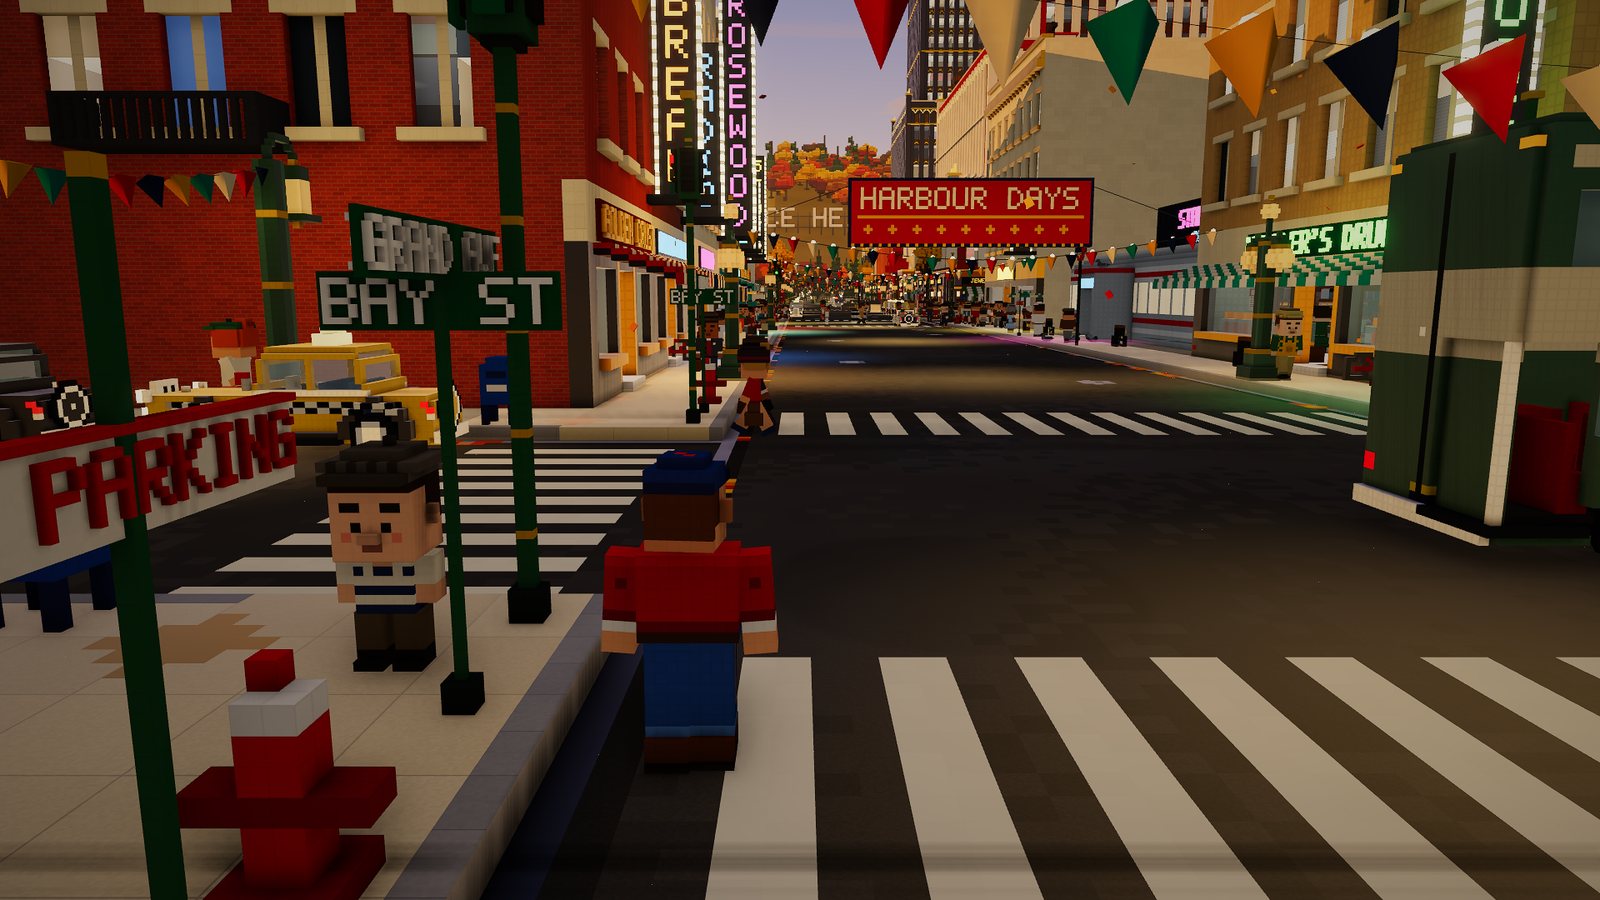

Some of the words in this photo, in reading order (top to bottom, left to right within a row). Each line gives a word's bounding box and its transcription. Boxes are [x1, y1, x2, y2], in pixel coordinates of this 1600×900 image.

[663, 0, 688, 182] BREA
[860, 186, 988, 210] HARBOUR
[1007, 186, 1080, 210] DAYS
[319, 277, 435, 325] BAY
[478, 277, 554, 325] ST
[713, 289, 734, 304] ST
[29, 408, 298, 547] PARKING
